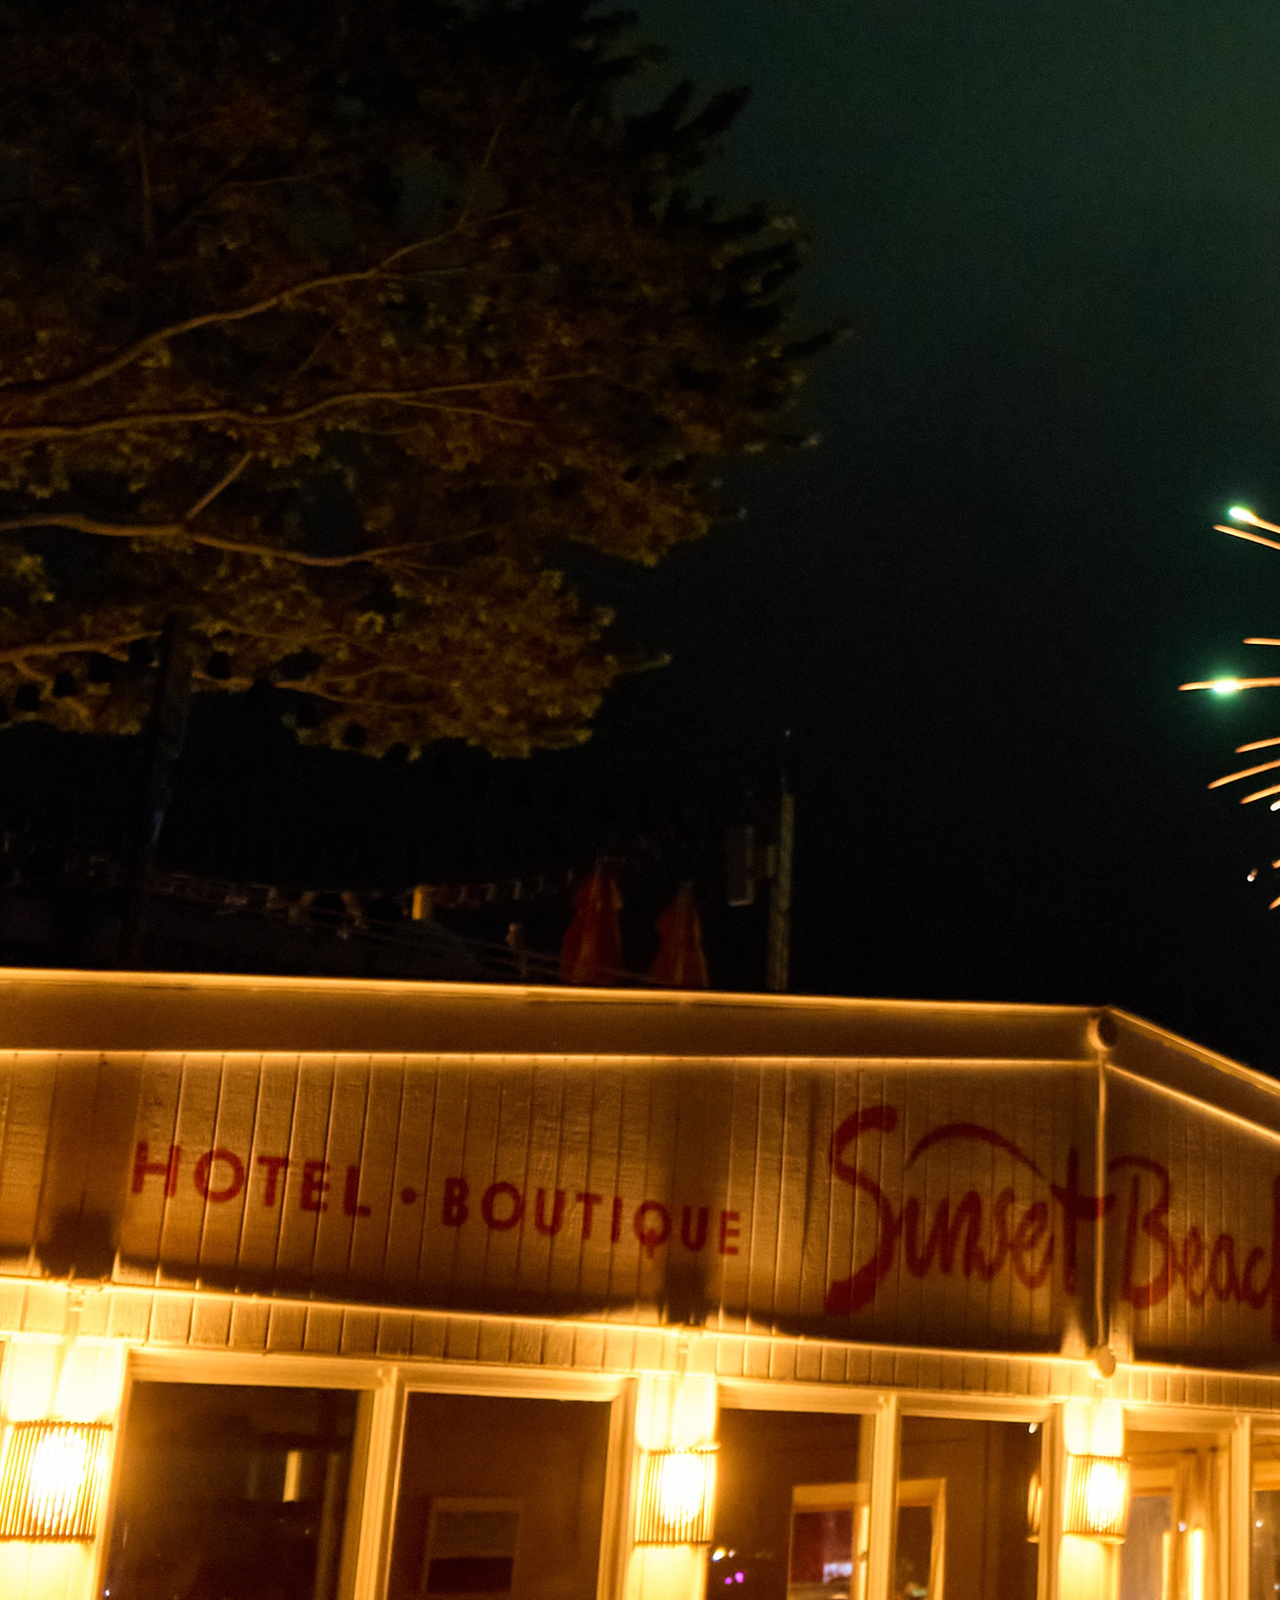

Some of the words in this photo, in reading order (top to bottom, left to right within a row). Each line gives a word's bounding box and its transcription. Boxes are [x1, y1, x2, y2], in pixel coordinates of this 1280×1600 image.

[131, 1141, 372, 1218] HOTEL
[441, 1177, 741, 1259] BOUTIQUE
[824, 1104, 1116, 1314] Sunset
